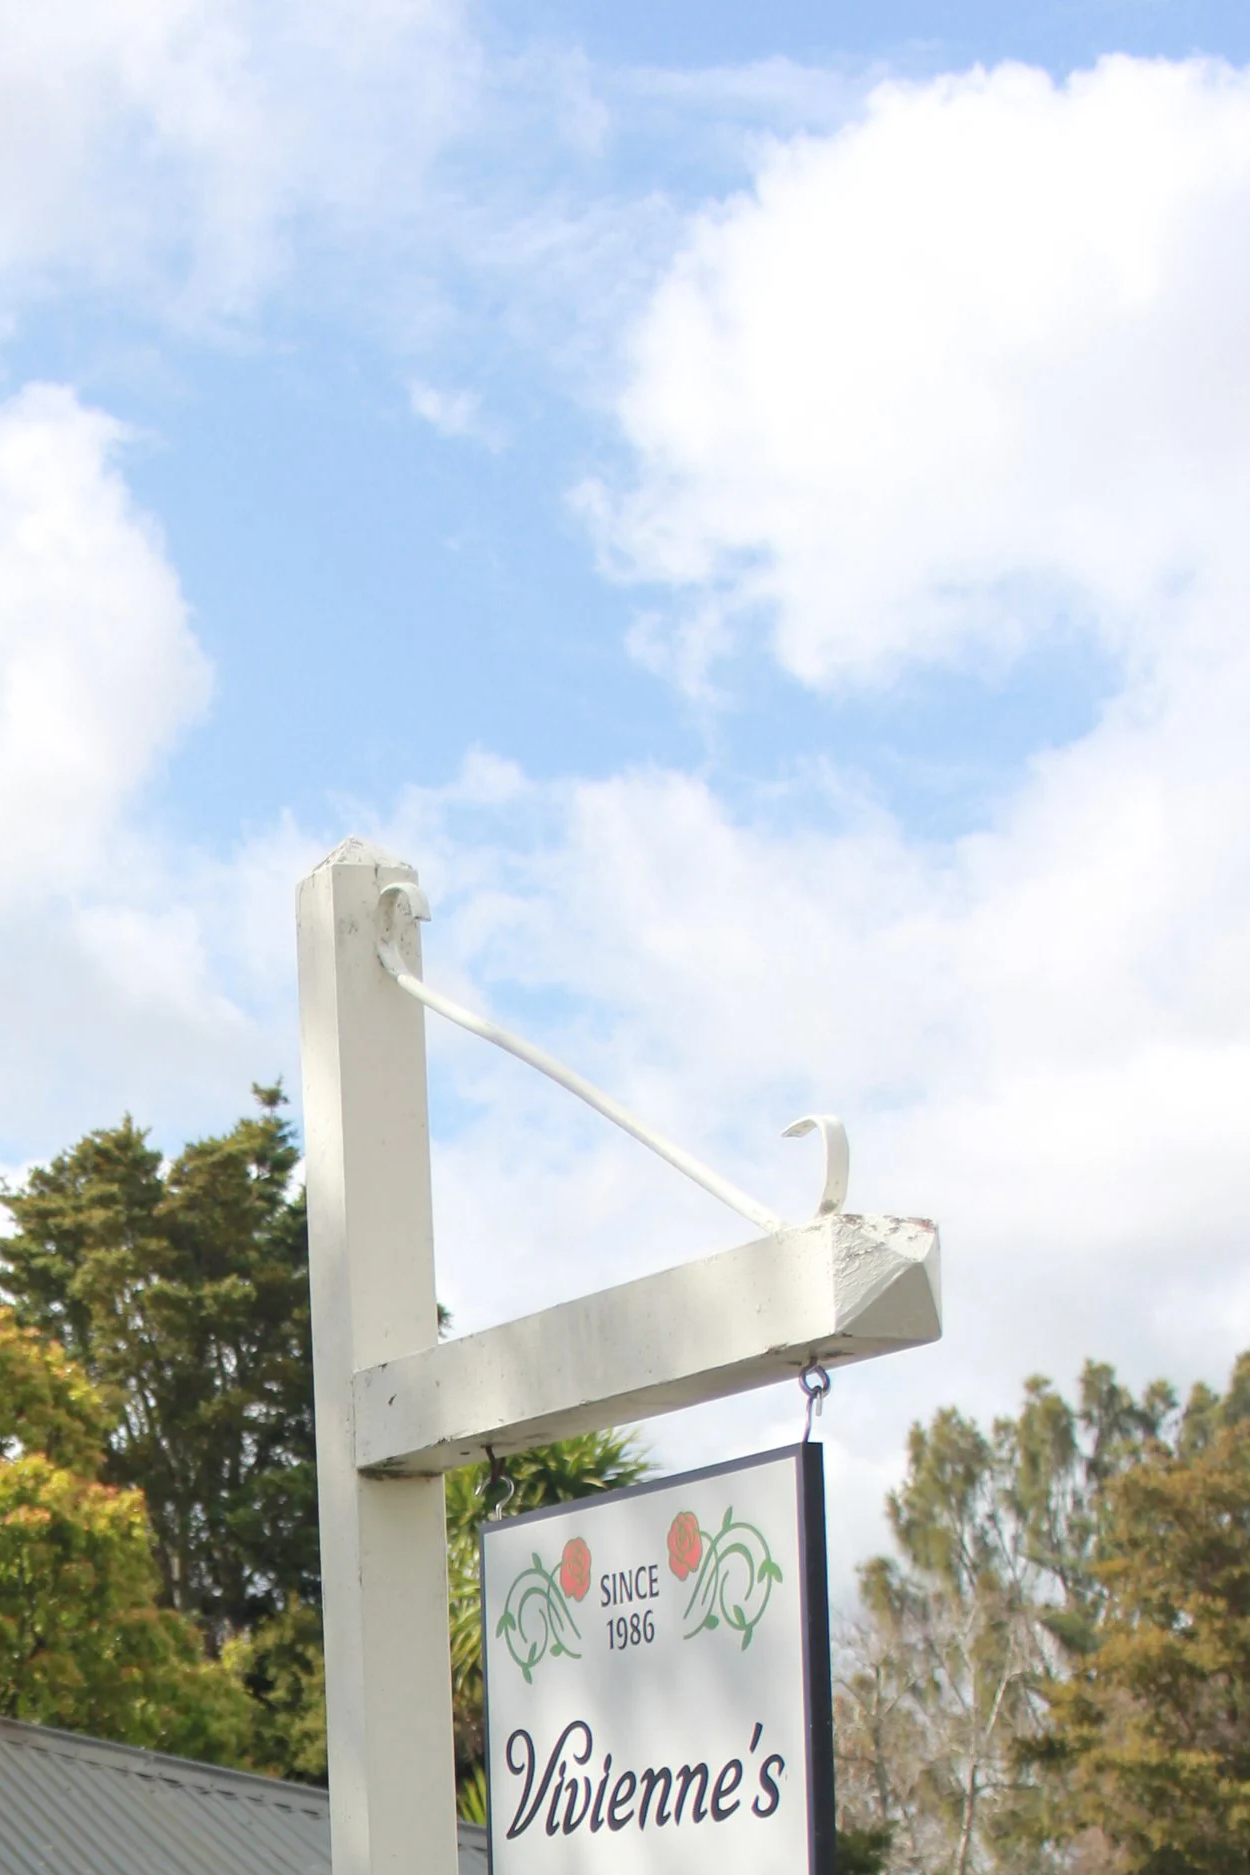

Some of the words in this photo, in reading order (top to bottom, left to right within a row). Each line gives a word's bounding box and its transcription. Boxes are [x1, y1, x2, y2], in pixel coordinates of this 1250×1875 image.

[600, 1564, 660, 1608] SINCE
[606, 1609, 655, 1650] 1986
[506, 1720, 786, 1840] Vivienne's
